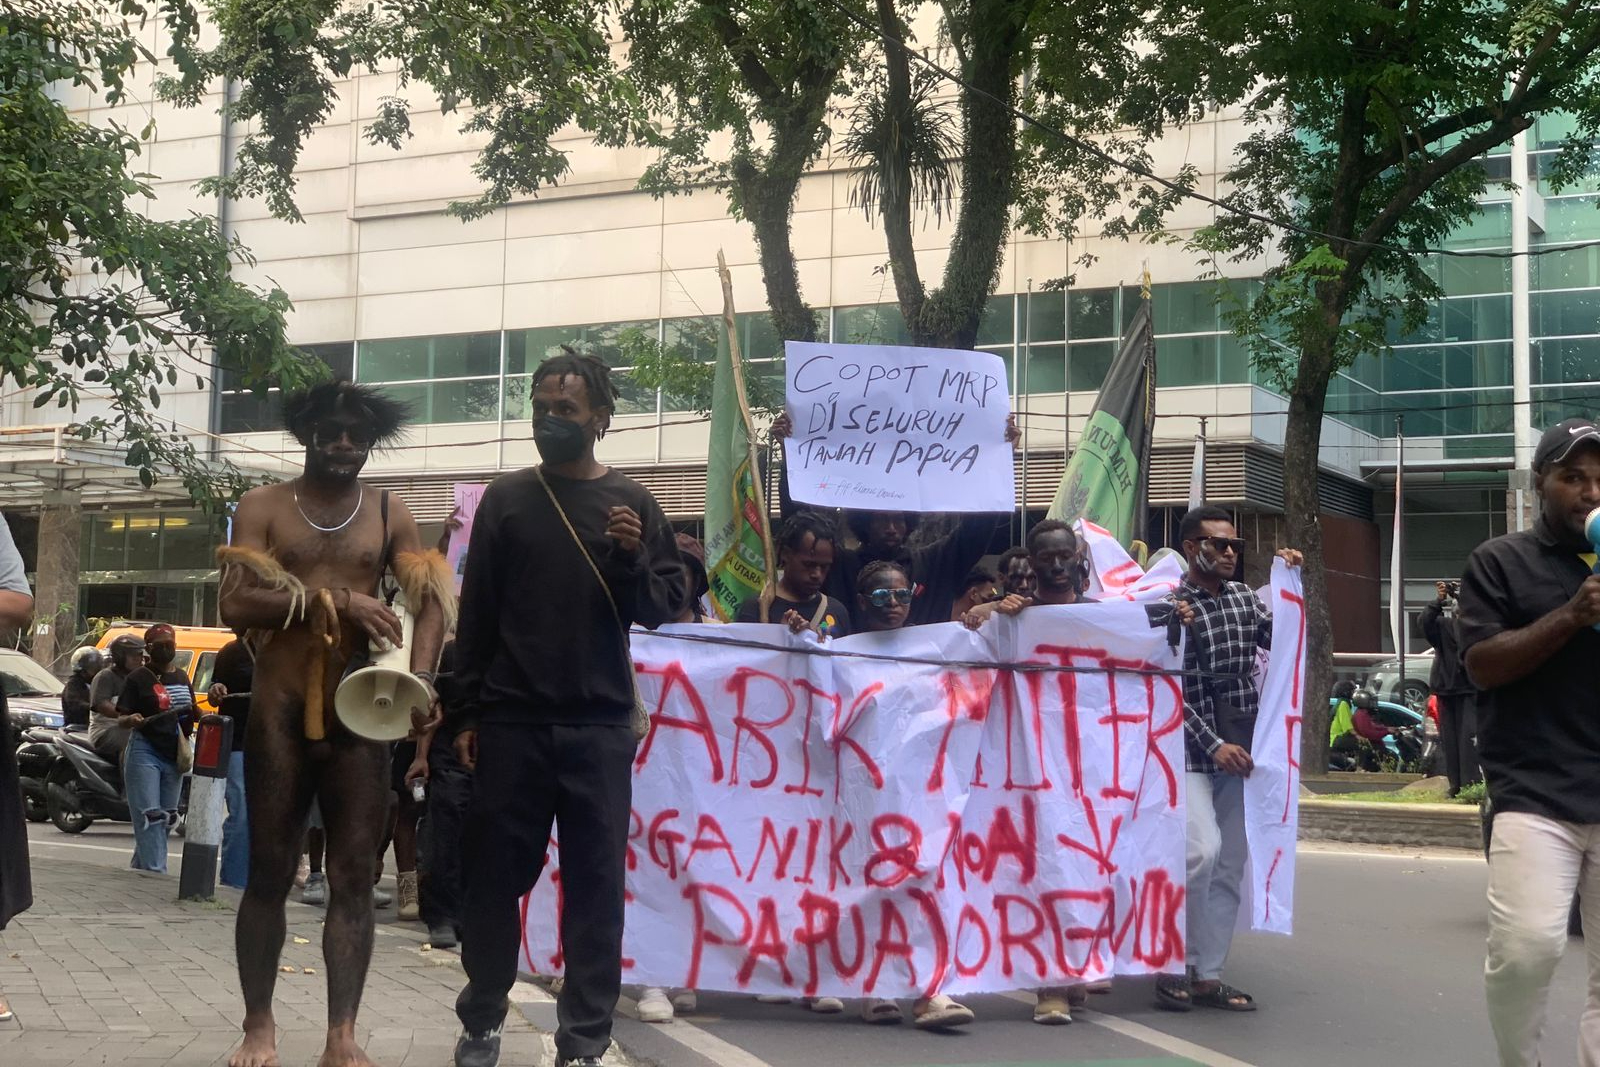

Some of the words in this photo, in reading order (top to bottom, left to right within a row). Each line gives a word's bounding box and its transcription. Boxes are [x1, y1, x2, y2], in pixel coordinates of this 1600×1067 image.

[794, 355, 928, 398] COPOT
[937, 368, 998, 408] MRP
[798, 436, 876, 469] TANAH
[885, 439, 980, 477] PAPUA
